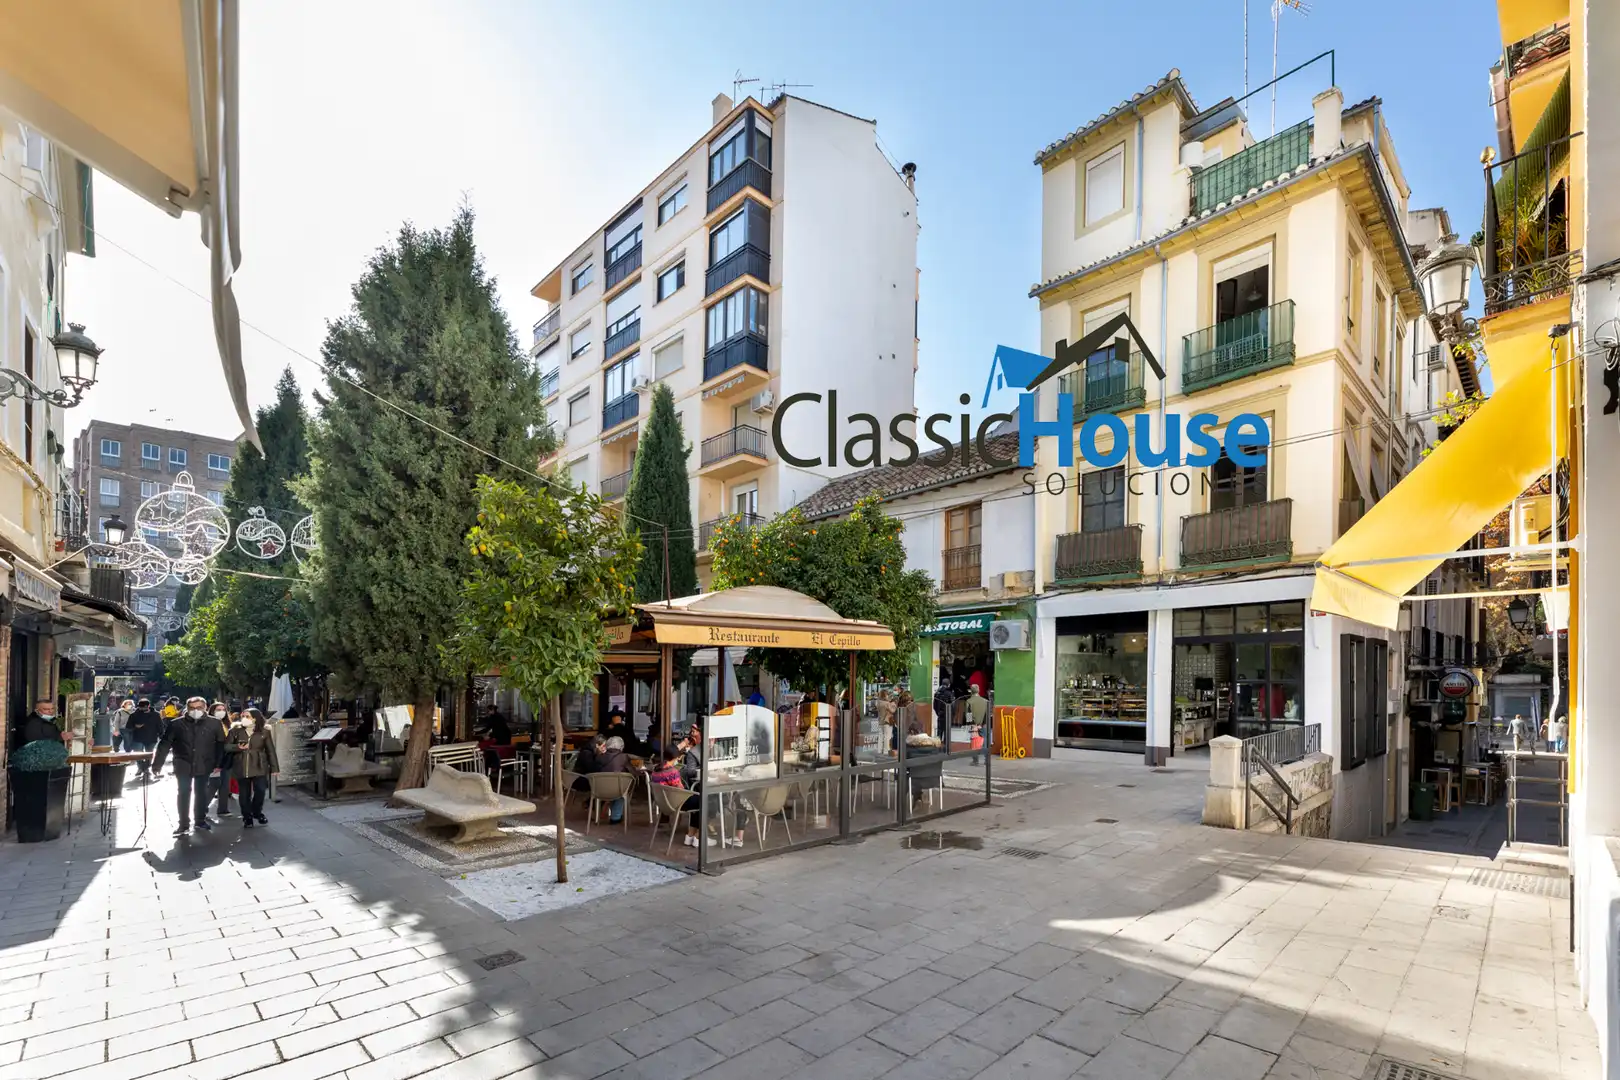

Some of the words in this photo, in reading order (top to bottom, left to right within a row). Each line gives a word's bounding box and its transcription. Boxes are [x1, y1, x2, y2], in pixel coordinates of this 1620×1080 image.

[708, 626, 780, 644] Restaurante
[811, 632, 824, 645] El
[829, 634, 862, 648] Cepillo
